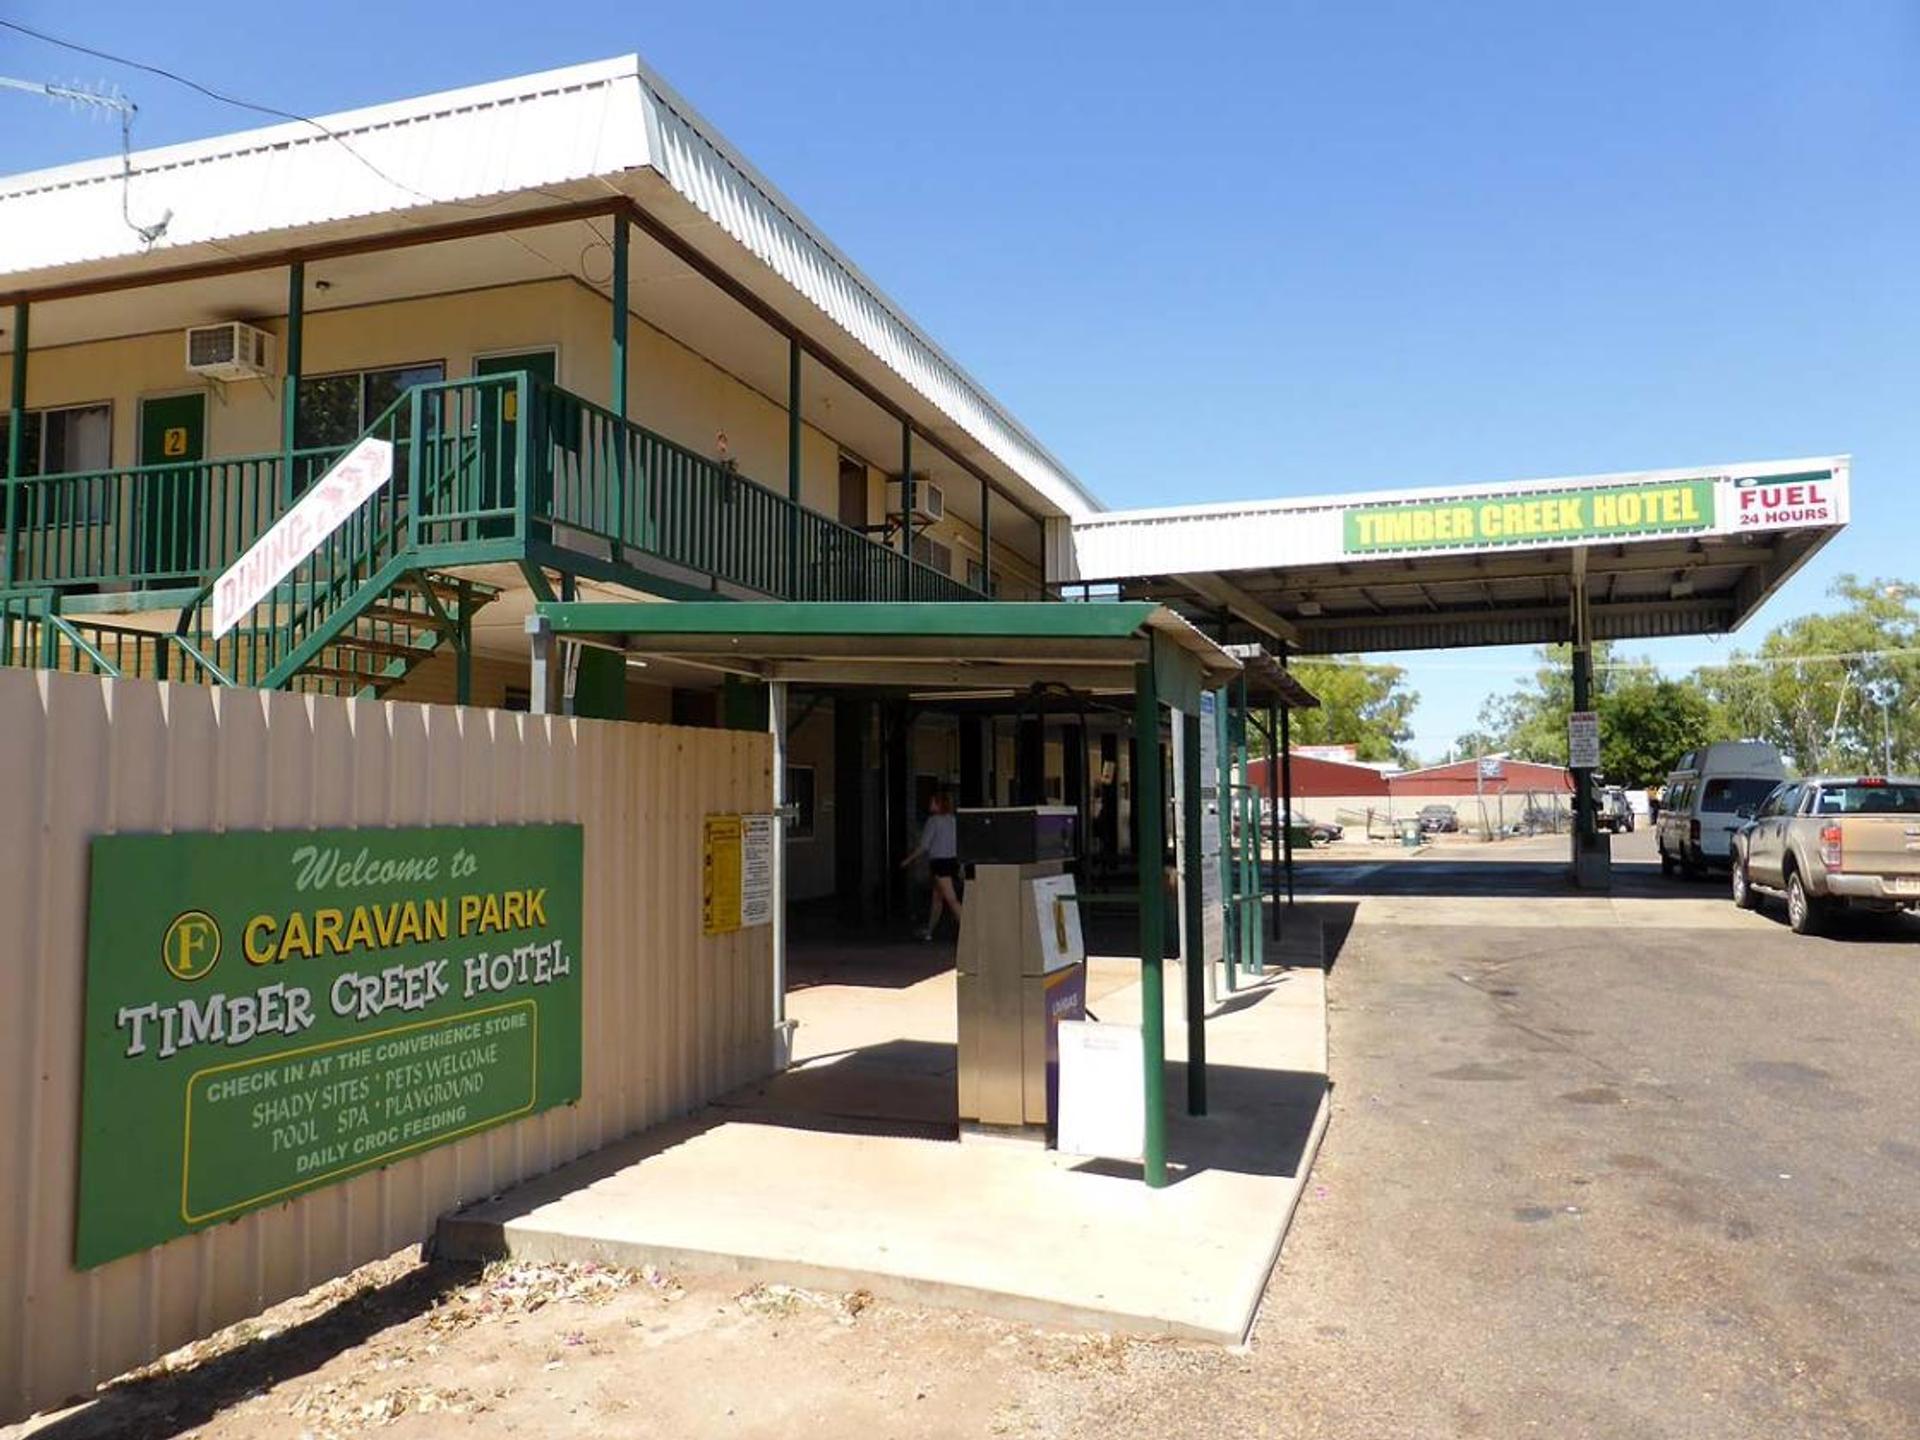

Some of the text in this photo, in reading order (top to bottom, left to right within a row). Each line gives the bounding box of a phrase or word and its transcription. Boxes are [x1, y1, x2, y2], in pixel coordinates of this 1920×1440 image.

[169, 430, 182, 454] 2
[1356, 487, 1700, 545] TIMBER CREEK HOTEL
[1740, 484, 1827, 510] FUEL
[1740, 507, 1829, 526] 24 HOURS
[220, 512, 312, 626] DINING
[291, 845, 478, 892] Welcome to
[243, 886, 548, 966] CARAVAN PARK
[116, 938, 571, 1059] TIMBER CREEK HOTEL
[206, 1012, 528, 1103] CHECK IN AT THE CONVENIENCE STORE
[251, 1043, 499, 1129] SHADY SITES PETS WELCOME
[272, 1071, 485, 1152] POOL SPA PLAYGROUND
[296, 1105, 467, 1173] DAILY CROC FEEDING
